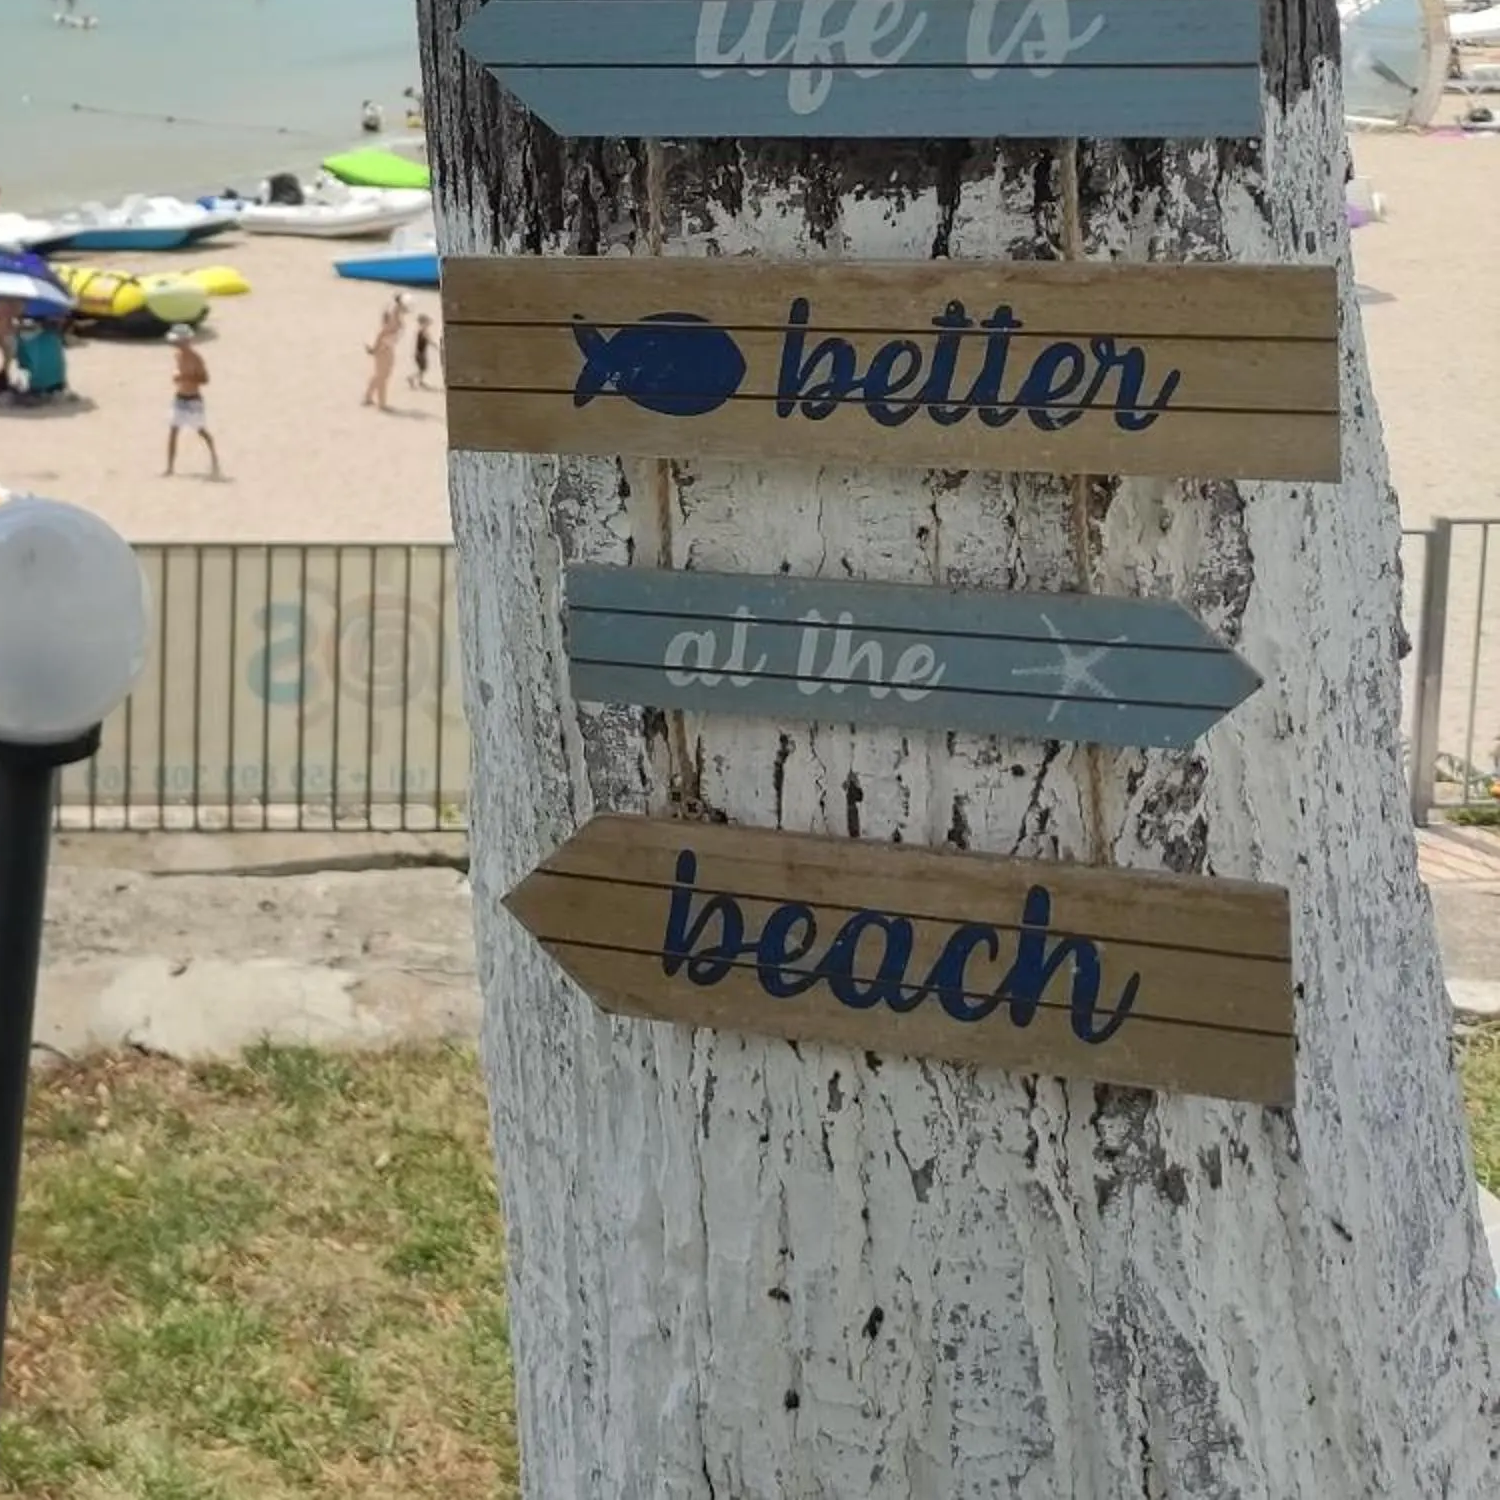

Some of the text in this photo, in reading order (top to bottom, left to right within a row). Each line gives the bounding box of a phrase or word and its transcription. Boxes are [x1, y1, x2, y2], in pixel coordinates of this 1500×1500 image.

[777, 297, 1181, 433] better
[663, 605, 946, 702] at the
[661, 848, 1141, 1046] beach
